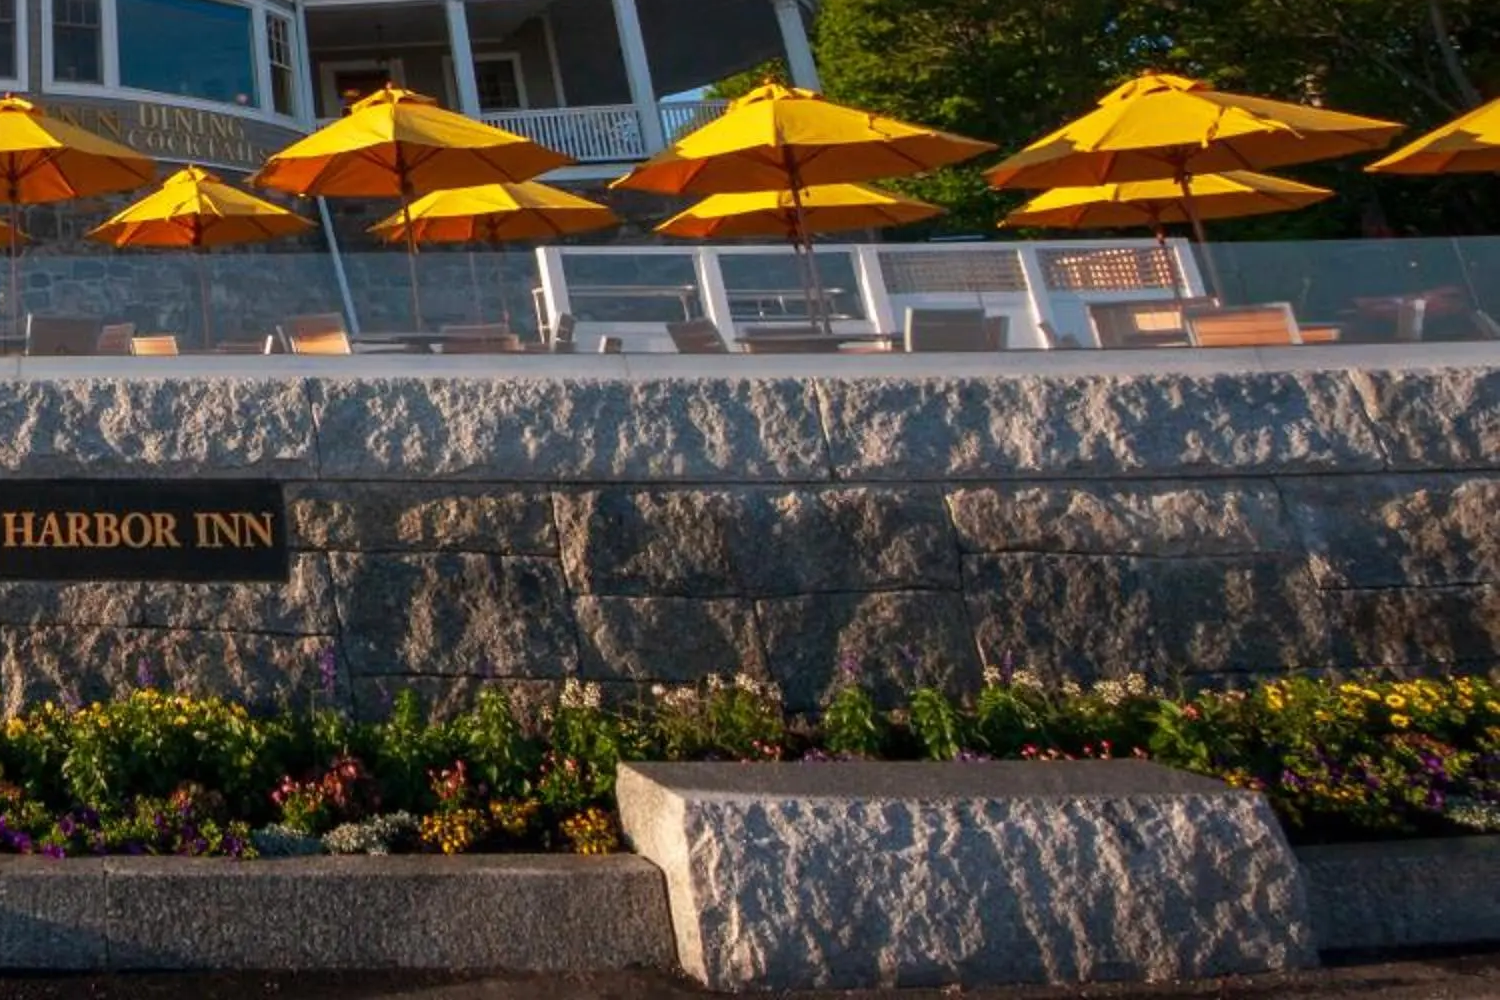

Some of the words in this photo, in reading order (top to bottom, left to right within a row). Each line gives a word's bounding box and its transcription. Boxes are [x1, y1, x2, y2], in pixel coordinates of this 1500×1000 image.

[139, 102, 246, 141] DINING
[2, 511, 182, 549] HARBOR
[193, 511, 275, 549] INN
